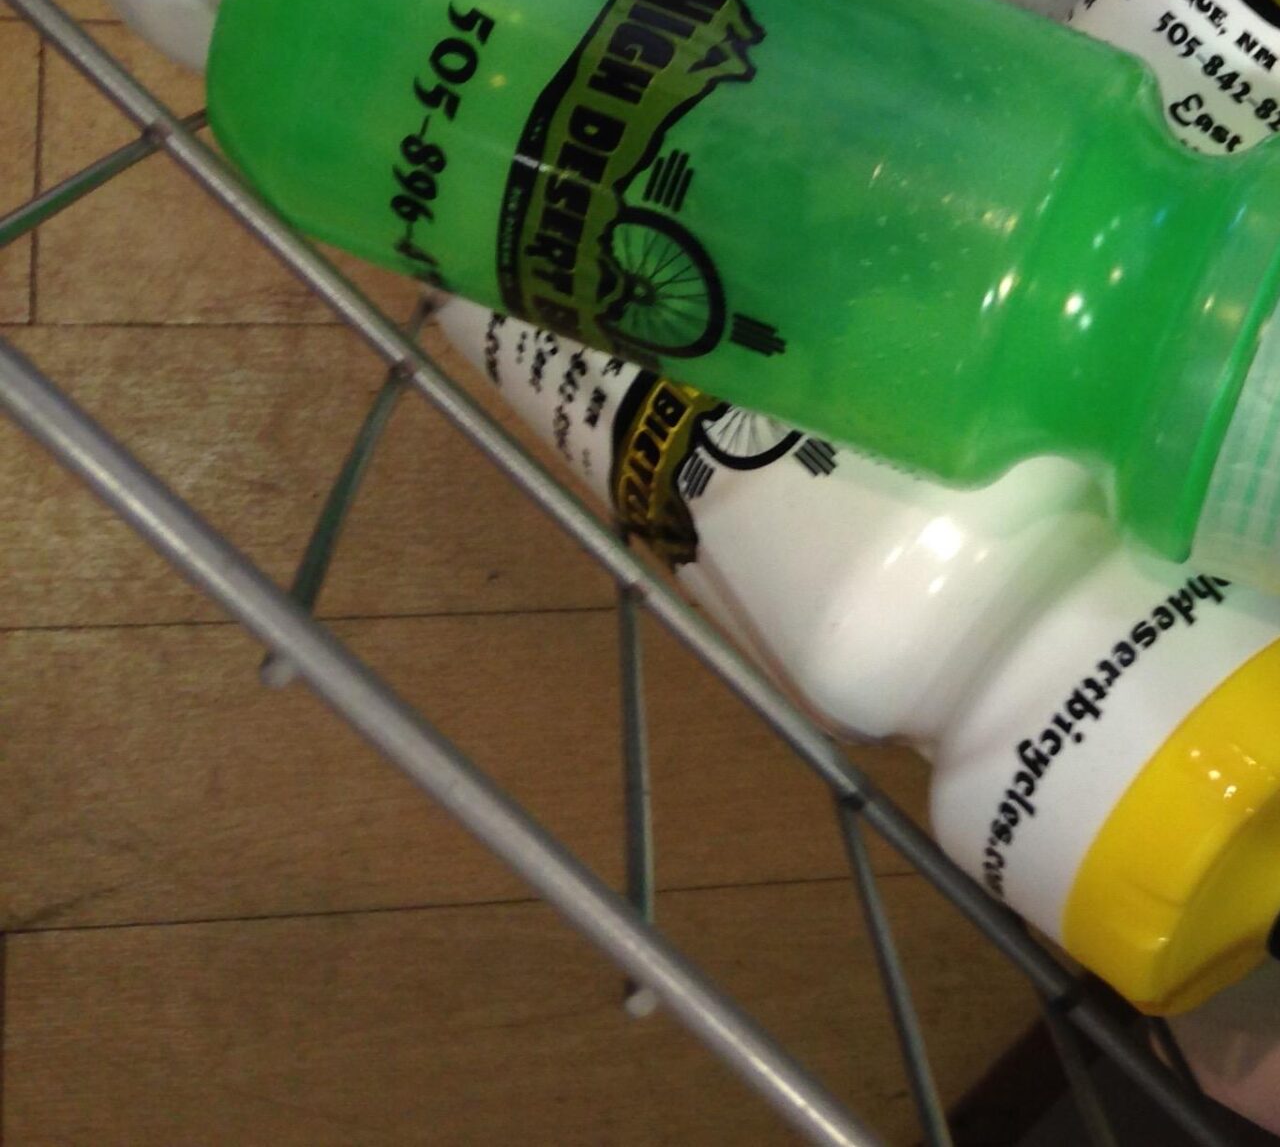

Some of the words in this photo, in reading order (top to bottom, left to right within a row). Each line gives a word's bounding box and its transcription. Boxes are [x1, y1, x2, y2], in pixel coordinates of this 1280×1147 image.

[1235, 30, 1280, 73] NM
[1168, 92, 1244, 155] East
[522, 103, 628, 298] DESERT
